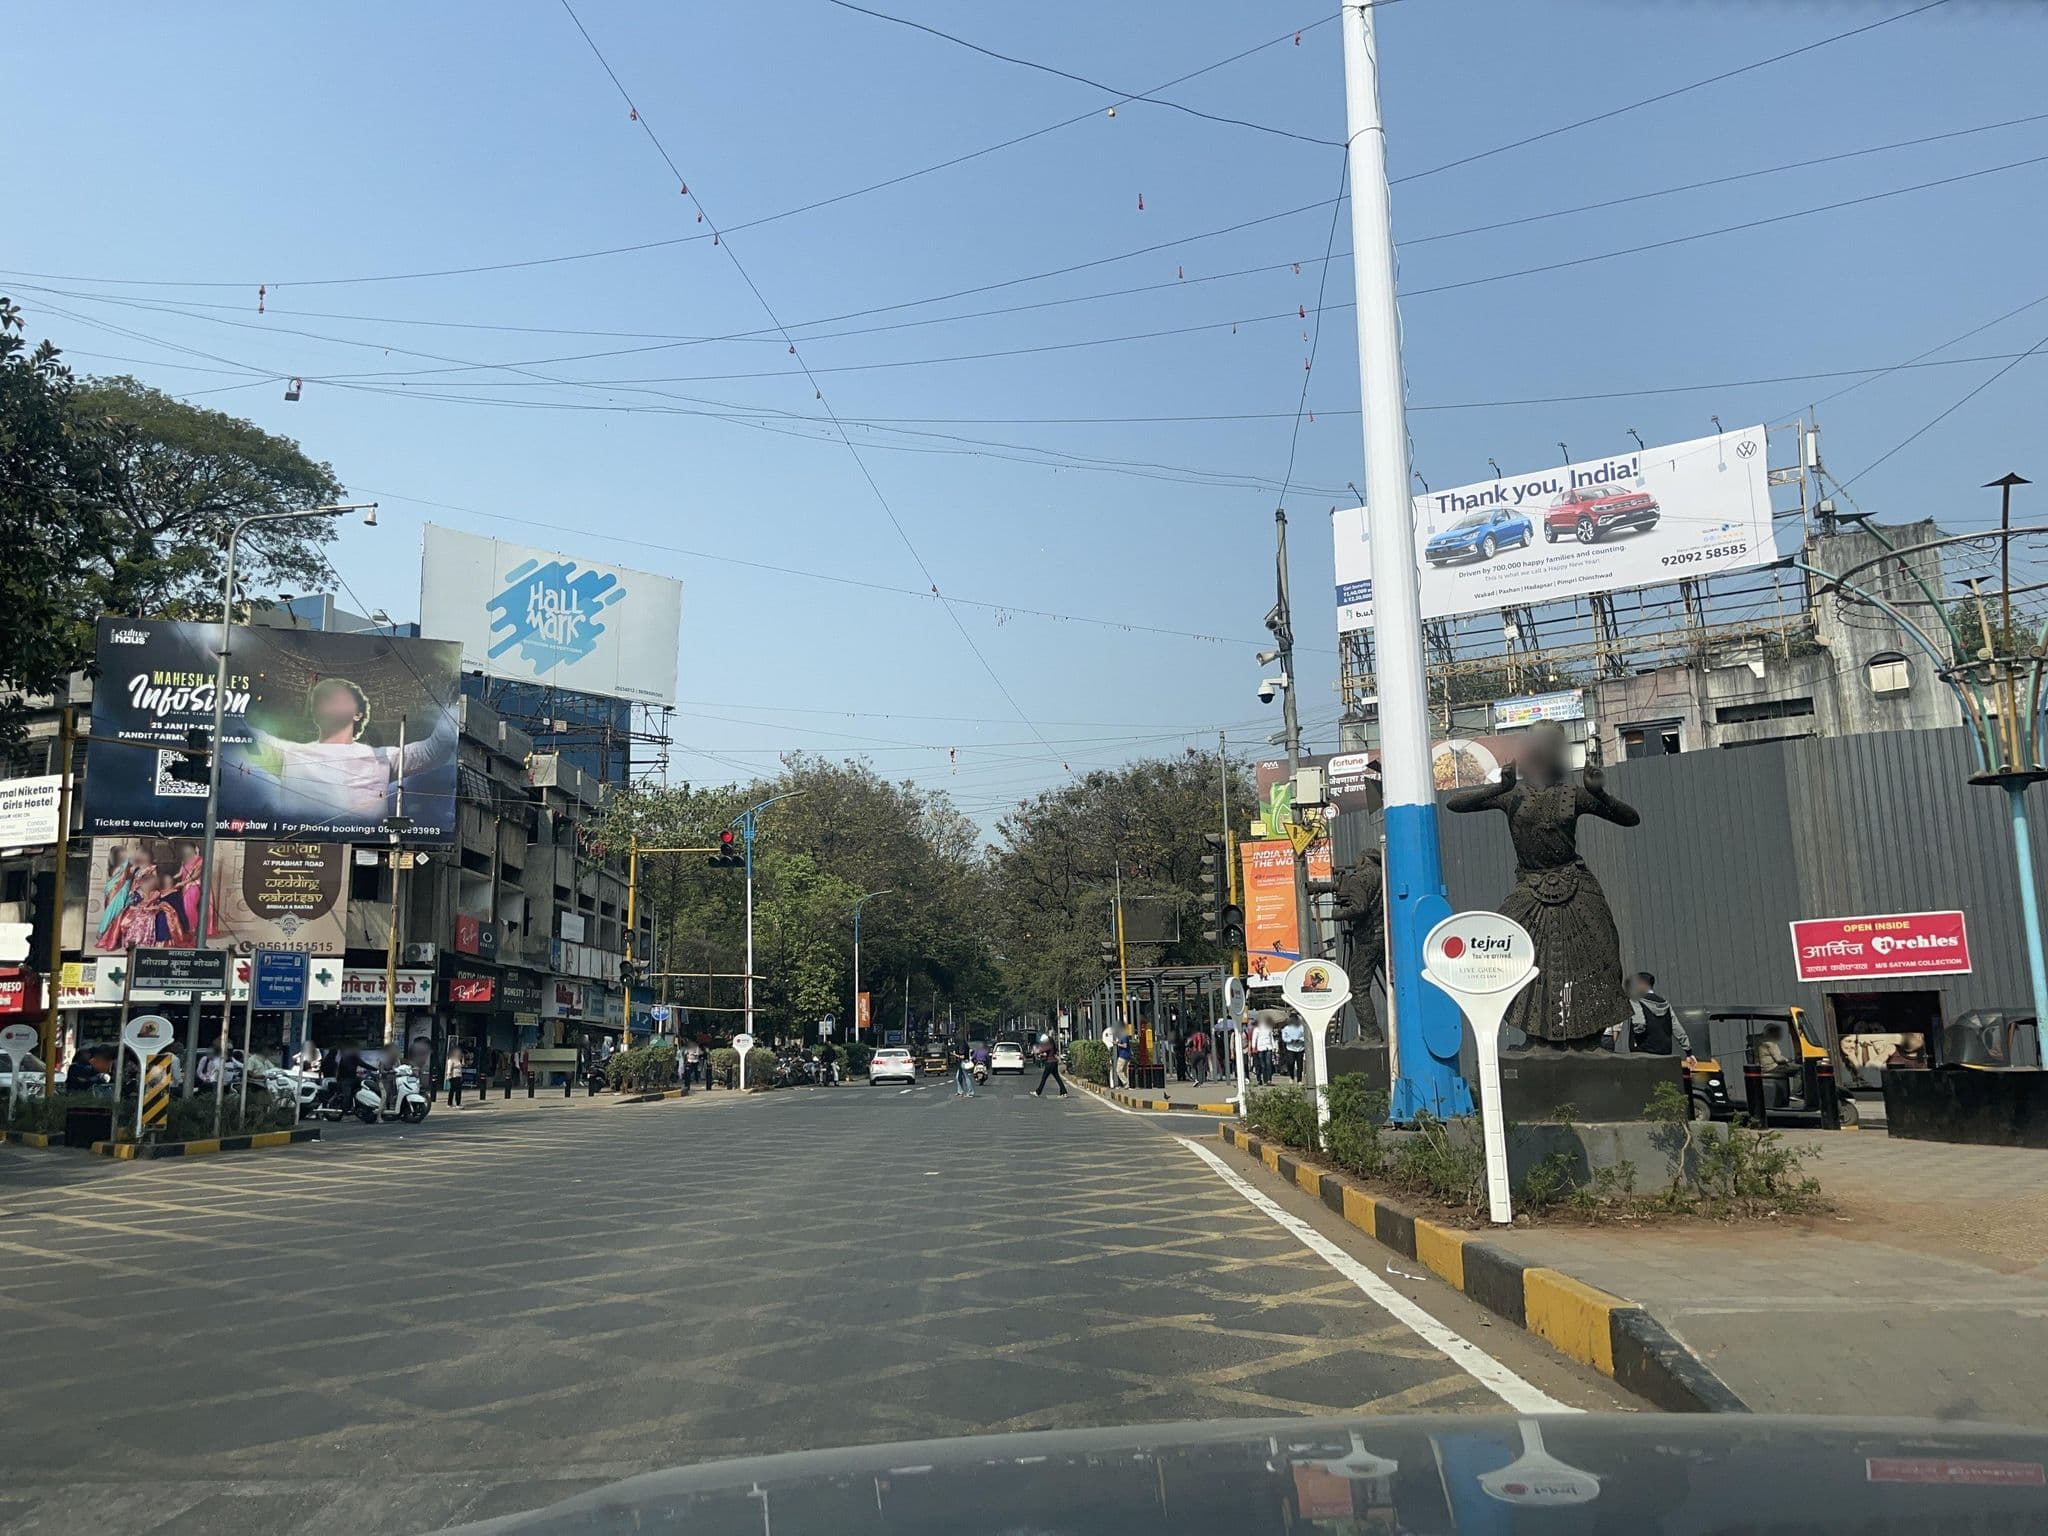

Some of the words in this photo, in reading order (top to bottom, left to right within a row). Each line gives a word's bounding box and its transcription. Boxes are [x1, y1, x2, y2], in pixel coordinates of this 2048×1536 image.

[1436, 484, 1508, 513] Thank
[1512, 478, 1564, 505] you,
[1570, 457, 1639, 489] India!
[1459, 569, 1481, 578] Driven
[1482, 567, 1491, 575] by
[1493, 561, 1521, 572] 700,000
[1522, 559, 1545, 568] happy
[1546, 553, 1575, 564] families
[1576, 550, 1590, 559] and
[1591, 544, 1627, 555] counting.
[1661, 551, 1703, 567] 92092
[1705, 543, 1747, 560] 58585
[1504, 571, 1519, 579] what
[1548, 564, 1568, 573] Happy
[1474, 590, 1495, 600] Wakad
[1498, 586, 1521, 595] Pashan
[1524, 582, 1553, 592] Hadapsar
[1557, 578, 1577, 586] Pimpri
[1578, 571, 1613, 582] Chinchwad
[526, 580, 584, 614] Hall
[525, 610, 586, 645] Mark
[115, 633, 146, 644] haus
[153, 671, 204, 688] MAHESH
[208, 673, 250, 690] KLE'S
[164, 722, 183, 731] JAN
[118, 731, 153, 740] PANDIT
[1332, 756, 1364, 768] fortune
[18, 785, 54, 797] Niketan
[3, 799, 23, 810] Girls
[24, 796, 54, 809] Hostel
[94, 818, 130, 827] Tickets
[132, 819, 189, 830] exclusively
[190, 821, 204, 829] on
[282, 822, 298, 831] For
[299, 823, 330, 833] Phone
[332, 824, 376, 835] bookings
[1253, 849, 1281, 860] INDIA
[271, 860, 303, 868] PRABHAT
[1254, 859, 1273, 868] THE
[265, 874, 321, 891] wedding
[258, 889, 323, 904] mahotsav
[1843, 924, 1873, 933] OPEN
[1874, 921, 1911, 931] INSIDE
[259, 941, 334, 953] 9561151515
[1470, 935, 1512, 952] tejraj
[1802, 939, 1864, 959] आर्चिज
[1888, 960, 1917, 968] SATYAM
[1917, 957, 1962, 967] COLLECTION
